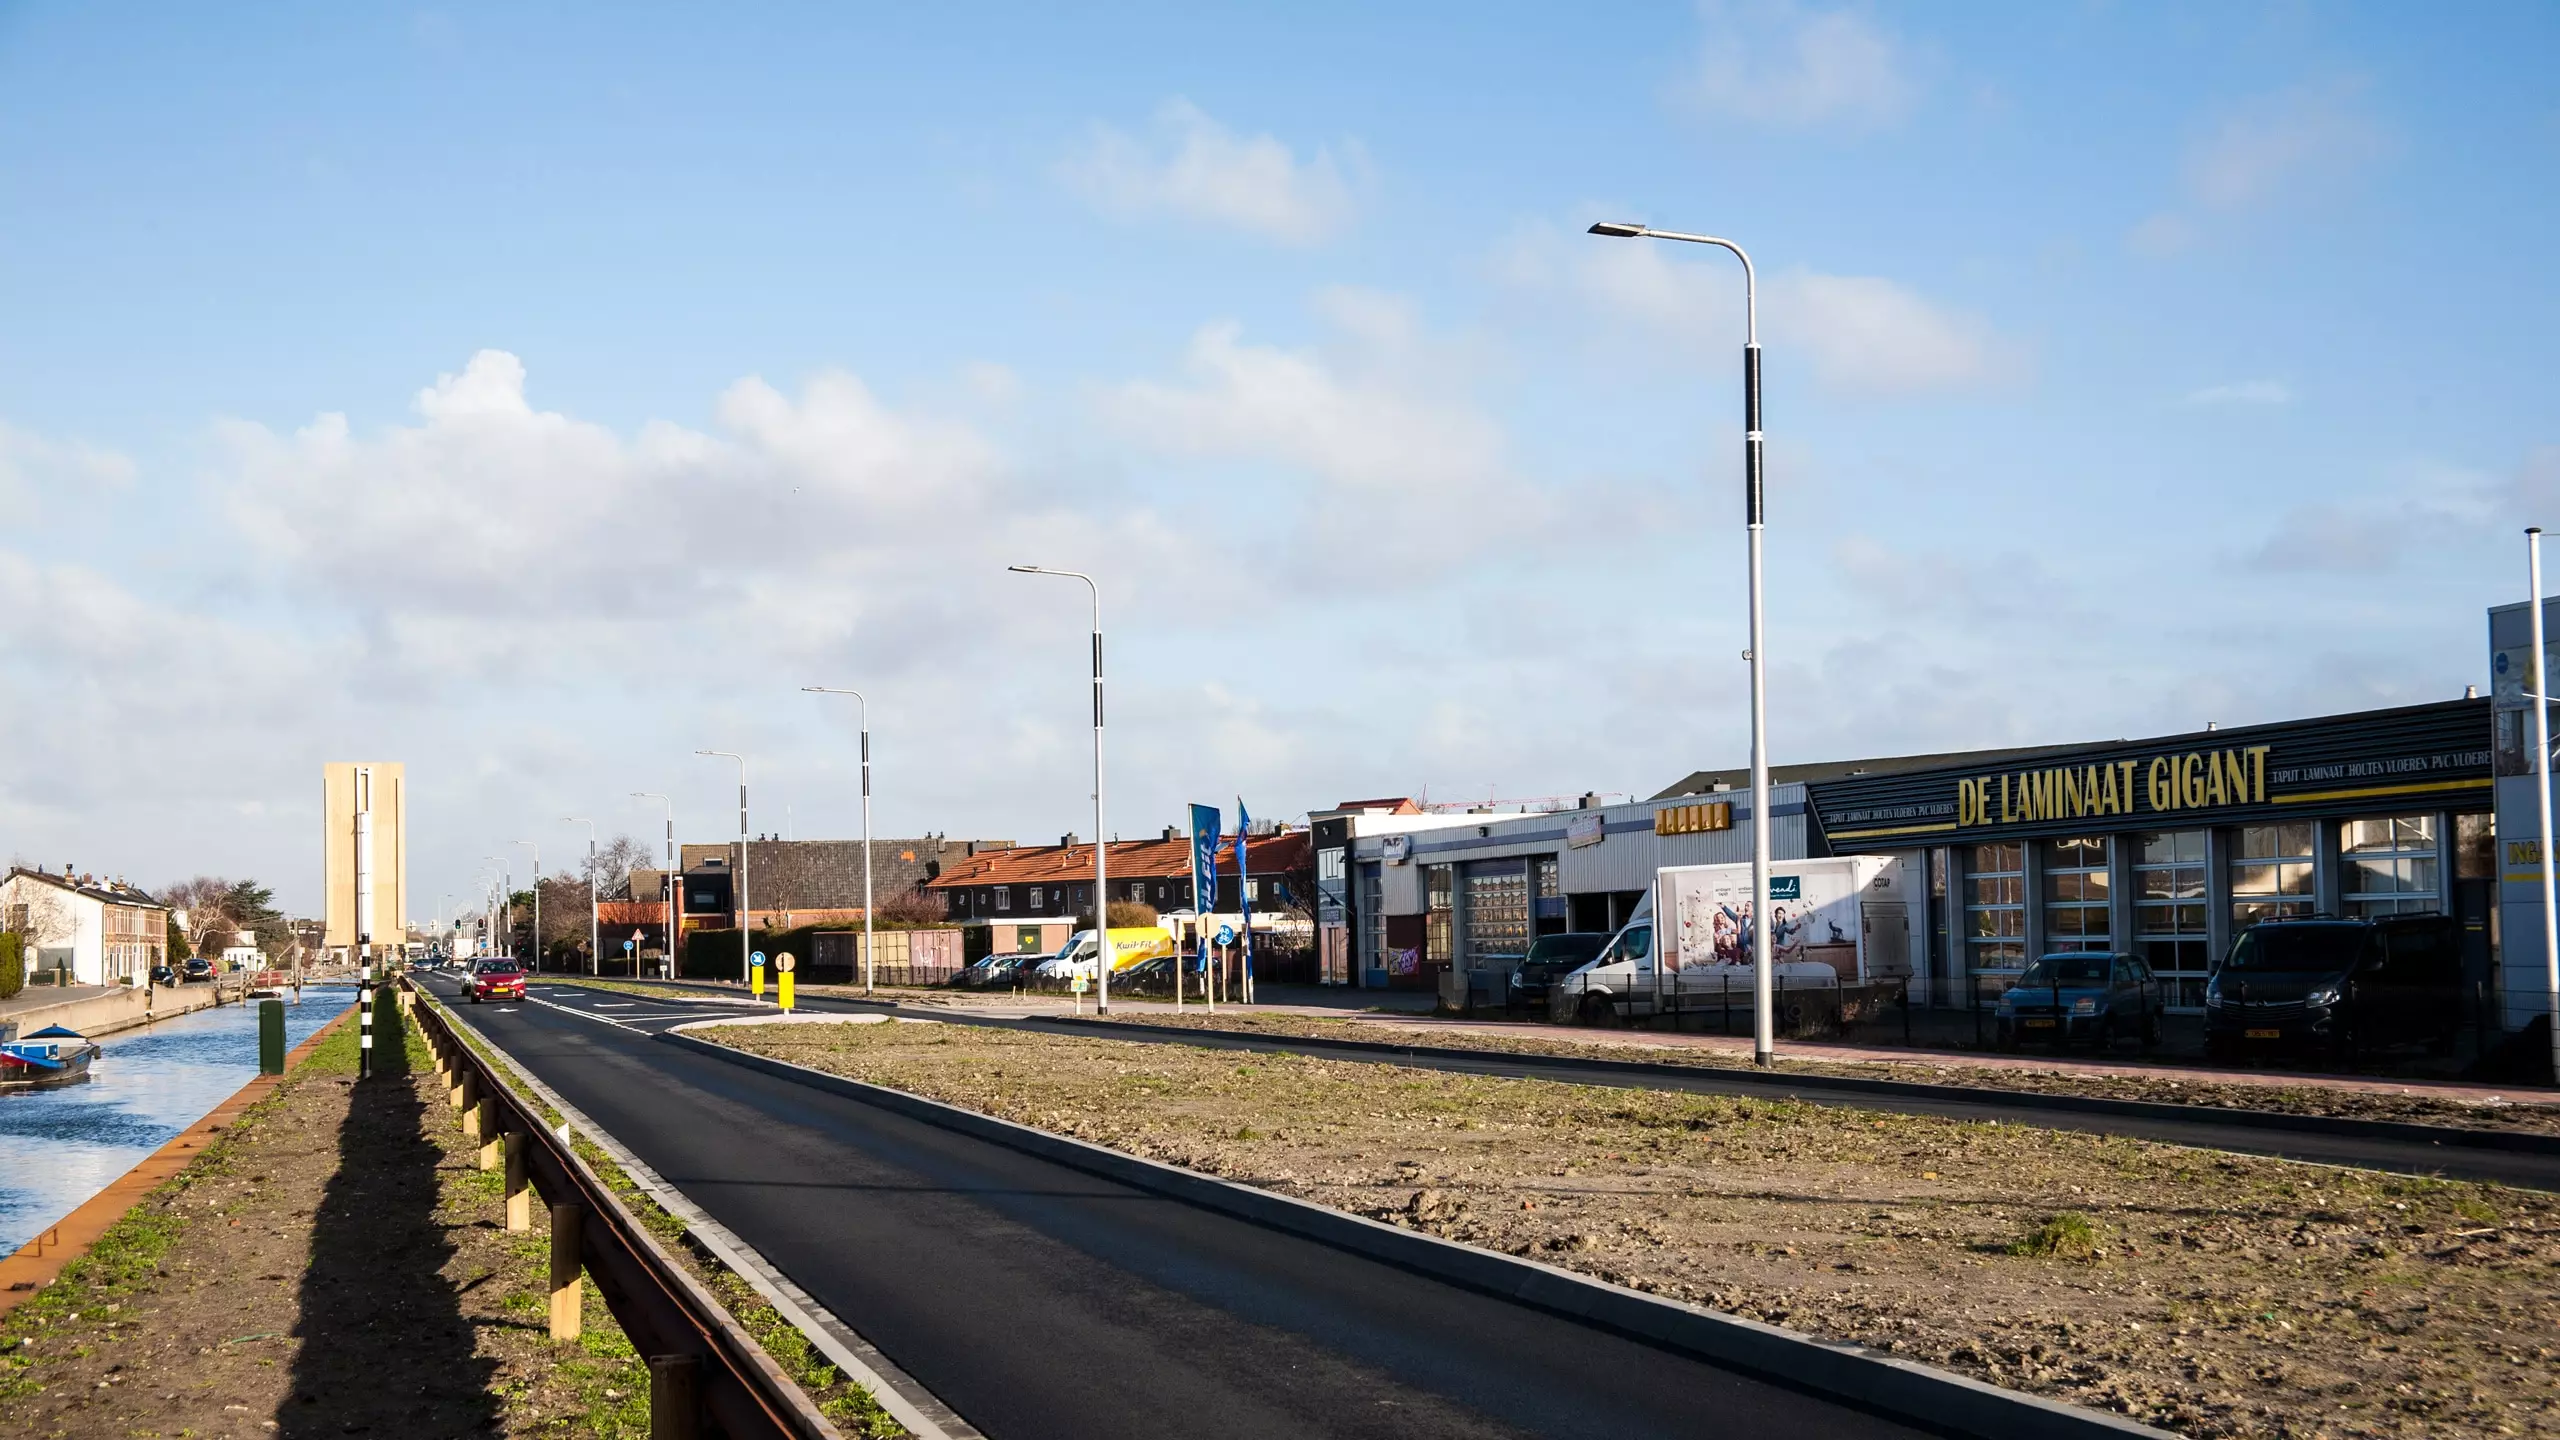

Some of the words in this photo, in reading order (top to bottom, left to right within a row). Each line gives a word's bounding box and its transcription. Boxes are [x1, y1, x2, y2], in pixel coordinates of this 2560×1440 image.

[1958, 776, 1992, 827] DE
[2001, 759, 2138, 823] LAMINAAT
[2148, 745, 2271, 812] GIGANT
[2272, 769, 2299, 783] TAPIJT
[2303, 765, 2344, 781] LAMINAAT
[2348, 761, 2385, 777] HOUTEN
[2385, 756, 2428, 773] VLOEREN
[2431, 754, 2450, 769] PVC
[2452, 750, 2492, 767] VLOERE
